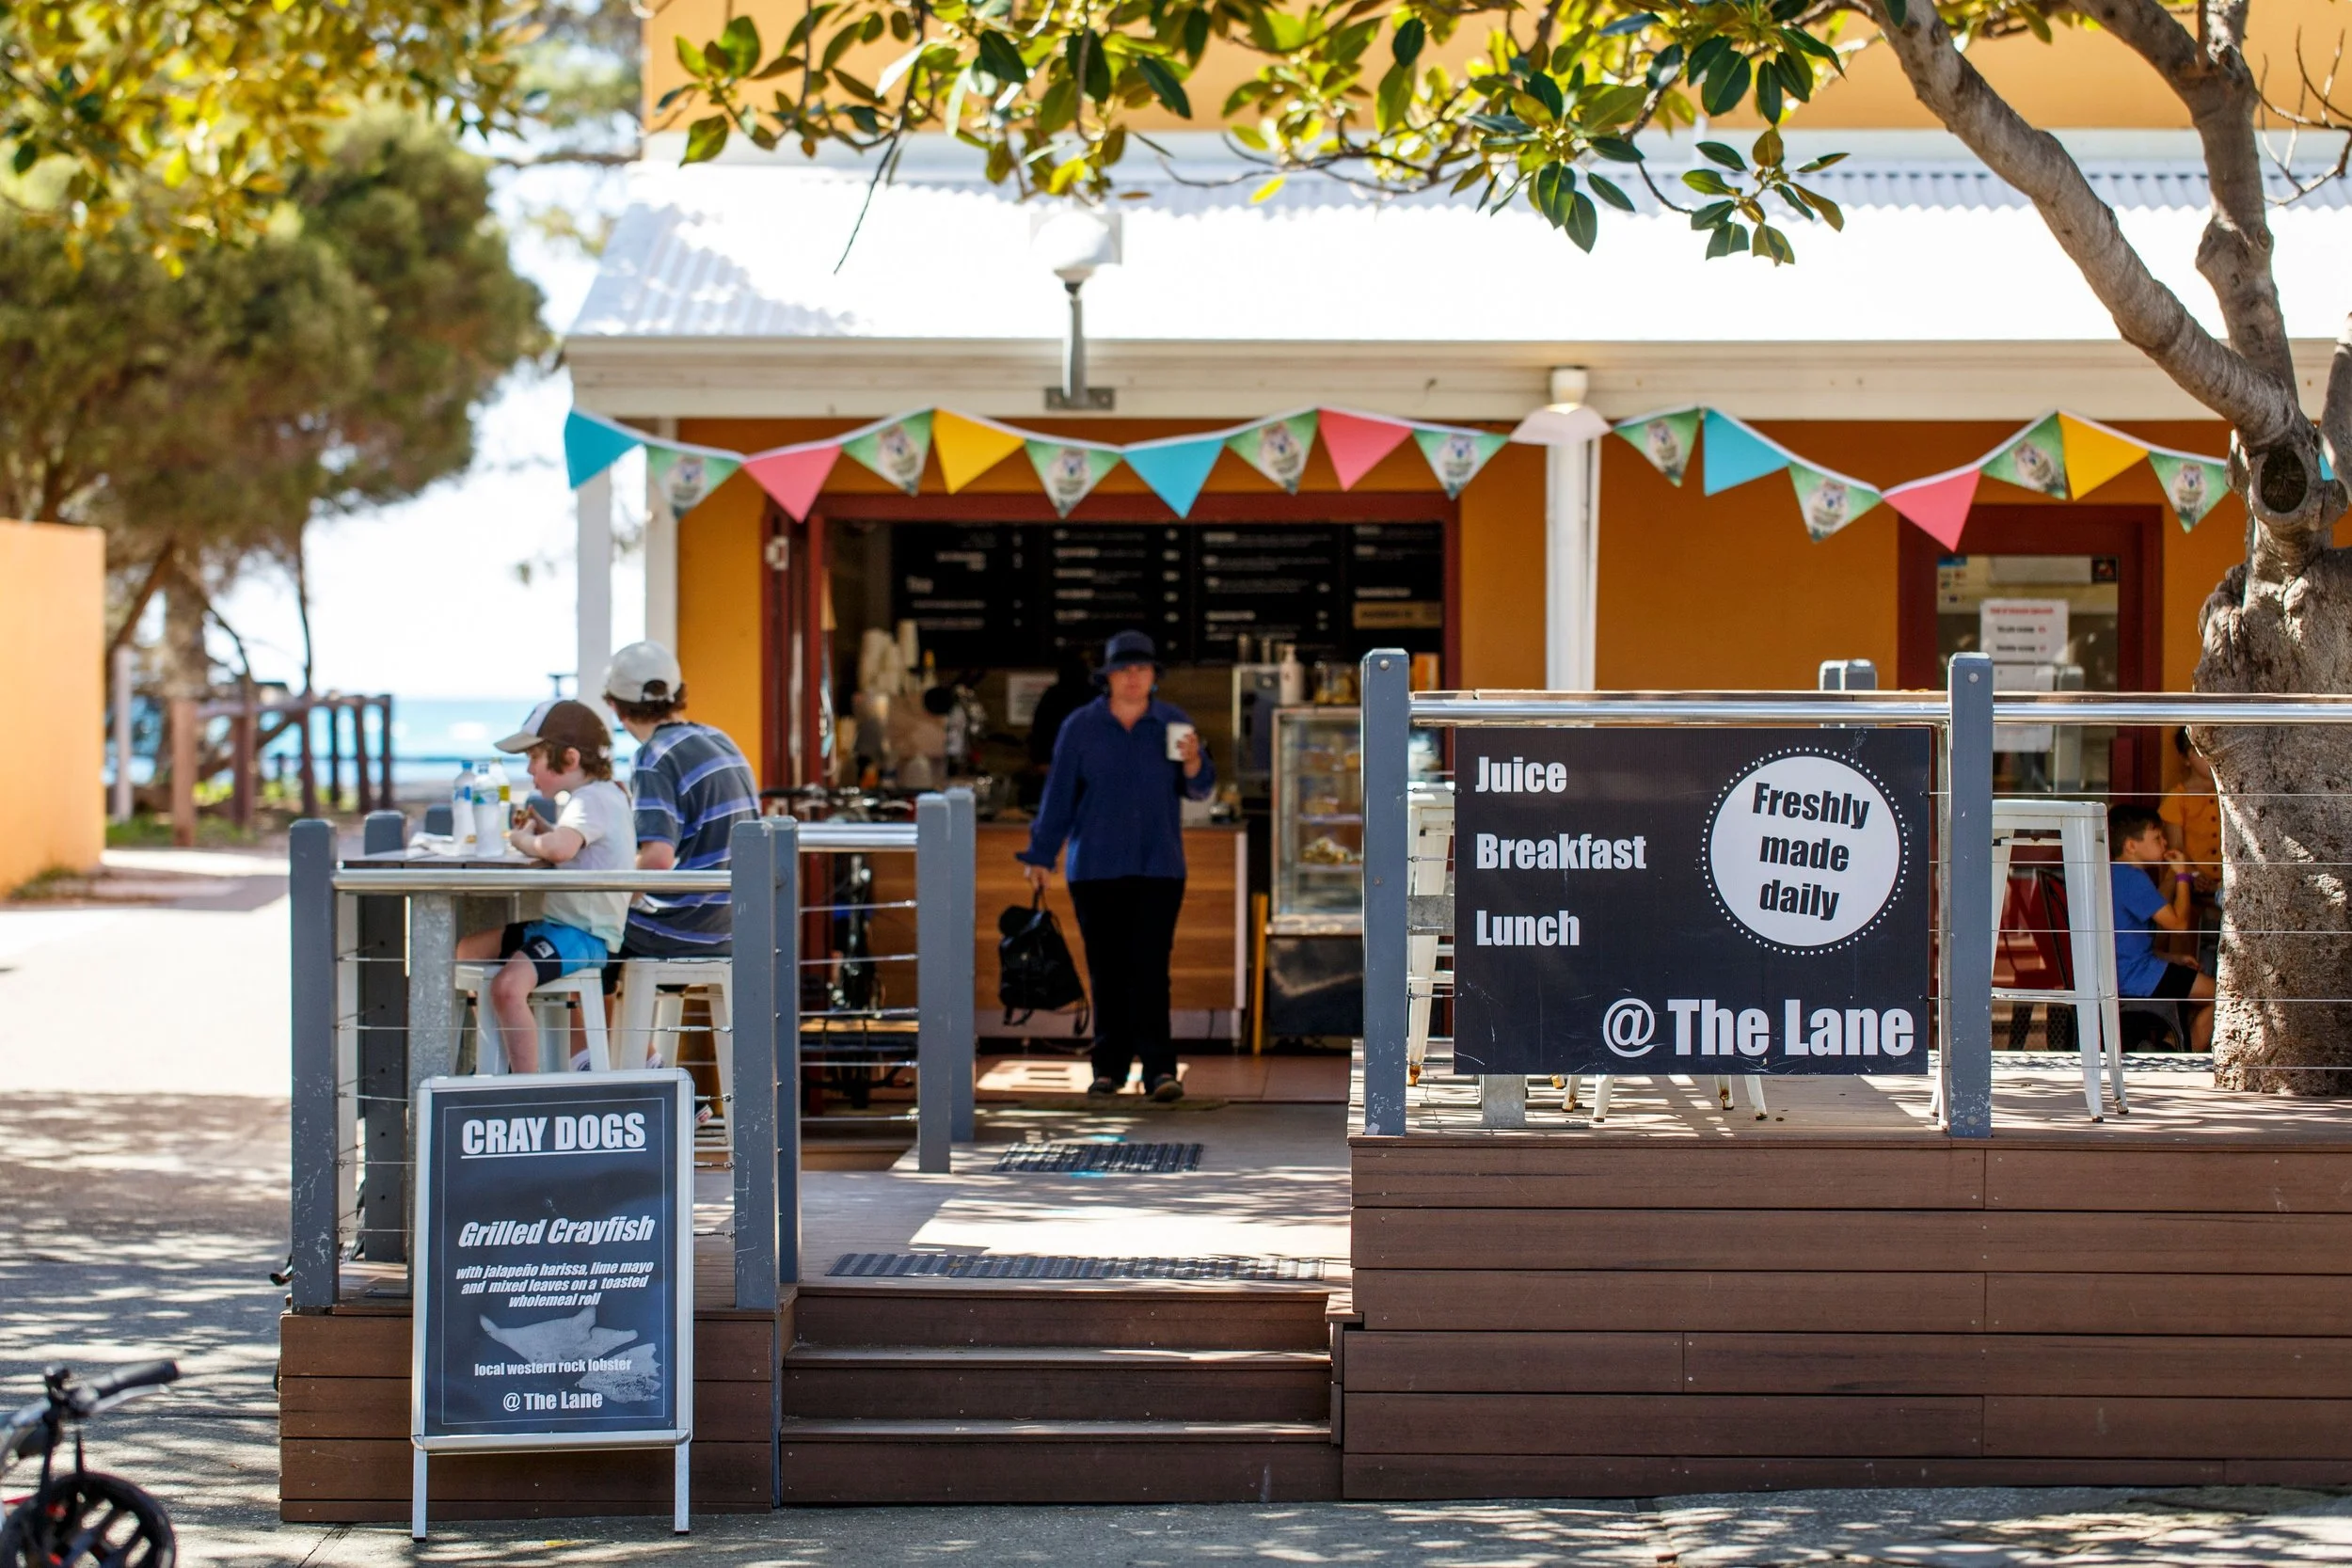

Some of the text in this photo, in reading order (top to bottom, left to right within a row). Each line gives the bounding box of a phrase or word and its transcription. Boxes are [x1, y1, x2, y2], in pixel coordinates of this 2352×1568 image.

[1475, 756, 1567, 793] Juice
[1753, 782, 1870, 831] Freshly
[1476, 833, 1646, 869] Breakfast
[1759, 832, 1850, 872] made
[1759, 879, 1840, 922] daily
[1476, 911, 1580, 946] Lunch
[1602, 998, 1914, 1057] @ The Lane
[462, 1113, 646, 1155] CRAY DOGS
[458, 1215, 656, 1247] Grilled Crayfish
[455, 1261, 654, 1279] with jalapeño harissa, lime mayo
[461, 1275, 650, 1294] and mixed leaves on a toasted
[508, 1291, 602, 1307] wholemeal roll
[474, 1358, 632, 1376] local western rock lobster
[503, 1391, 603, 1412] @ The Lane
